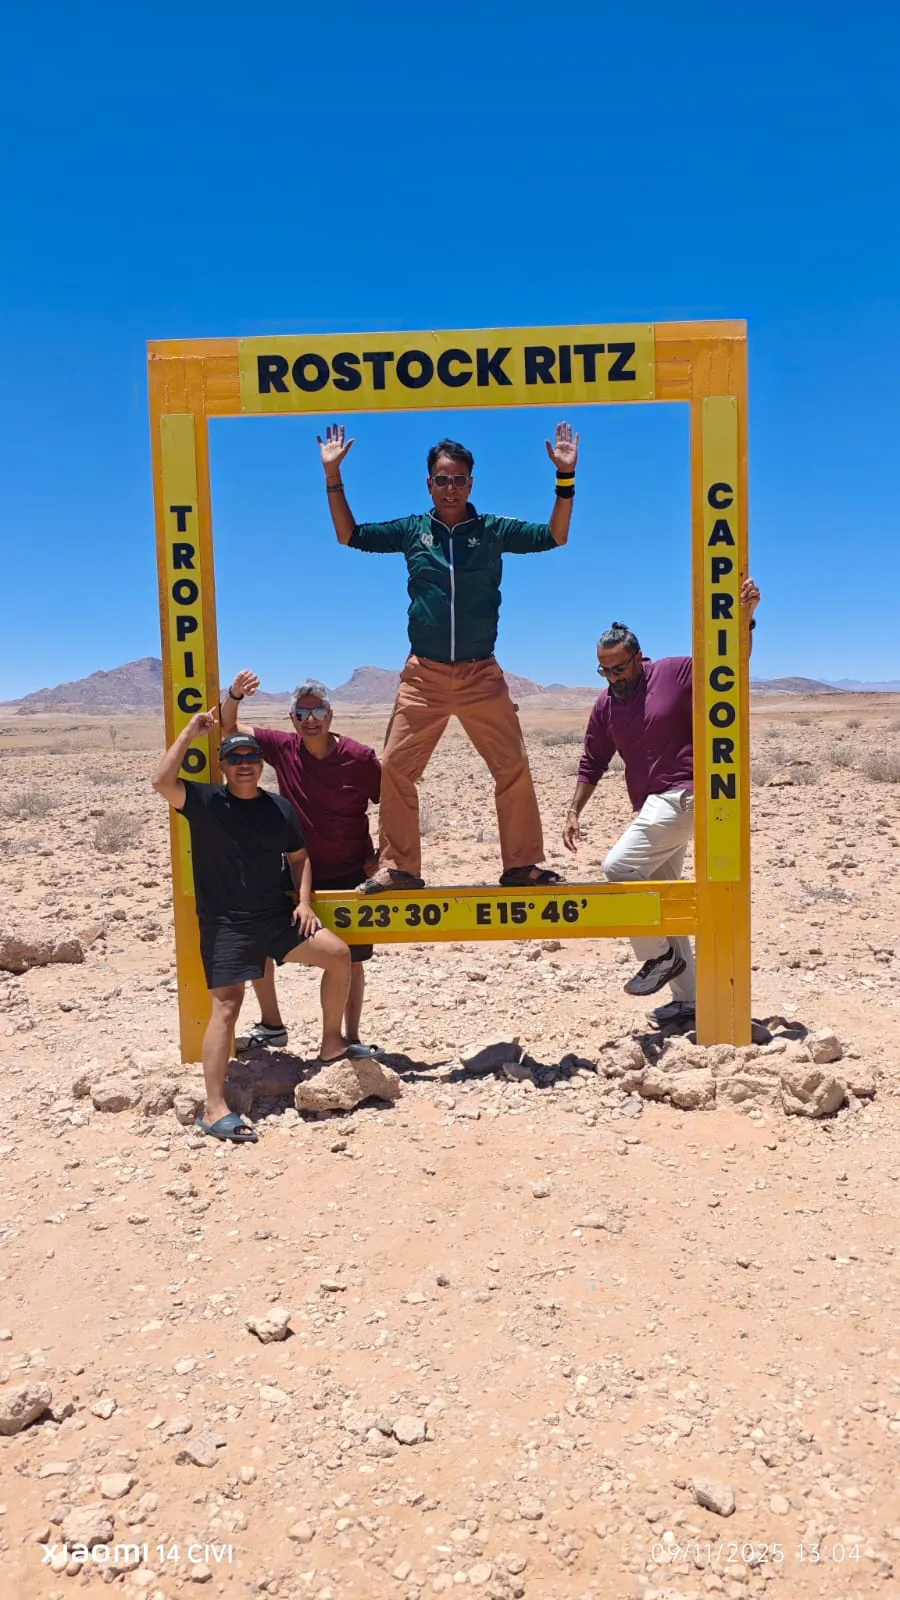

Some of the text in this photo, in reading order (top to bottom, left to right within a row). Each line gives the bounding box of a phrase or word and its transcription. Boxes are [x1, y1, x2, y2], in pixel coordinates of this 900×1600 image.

[256, 342, 637, 394] ROSTOCK RITZ
[169, 505, 203, 714] TROPIC
[707, 482, 736, 800] CAPRICORN
